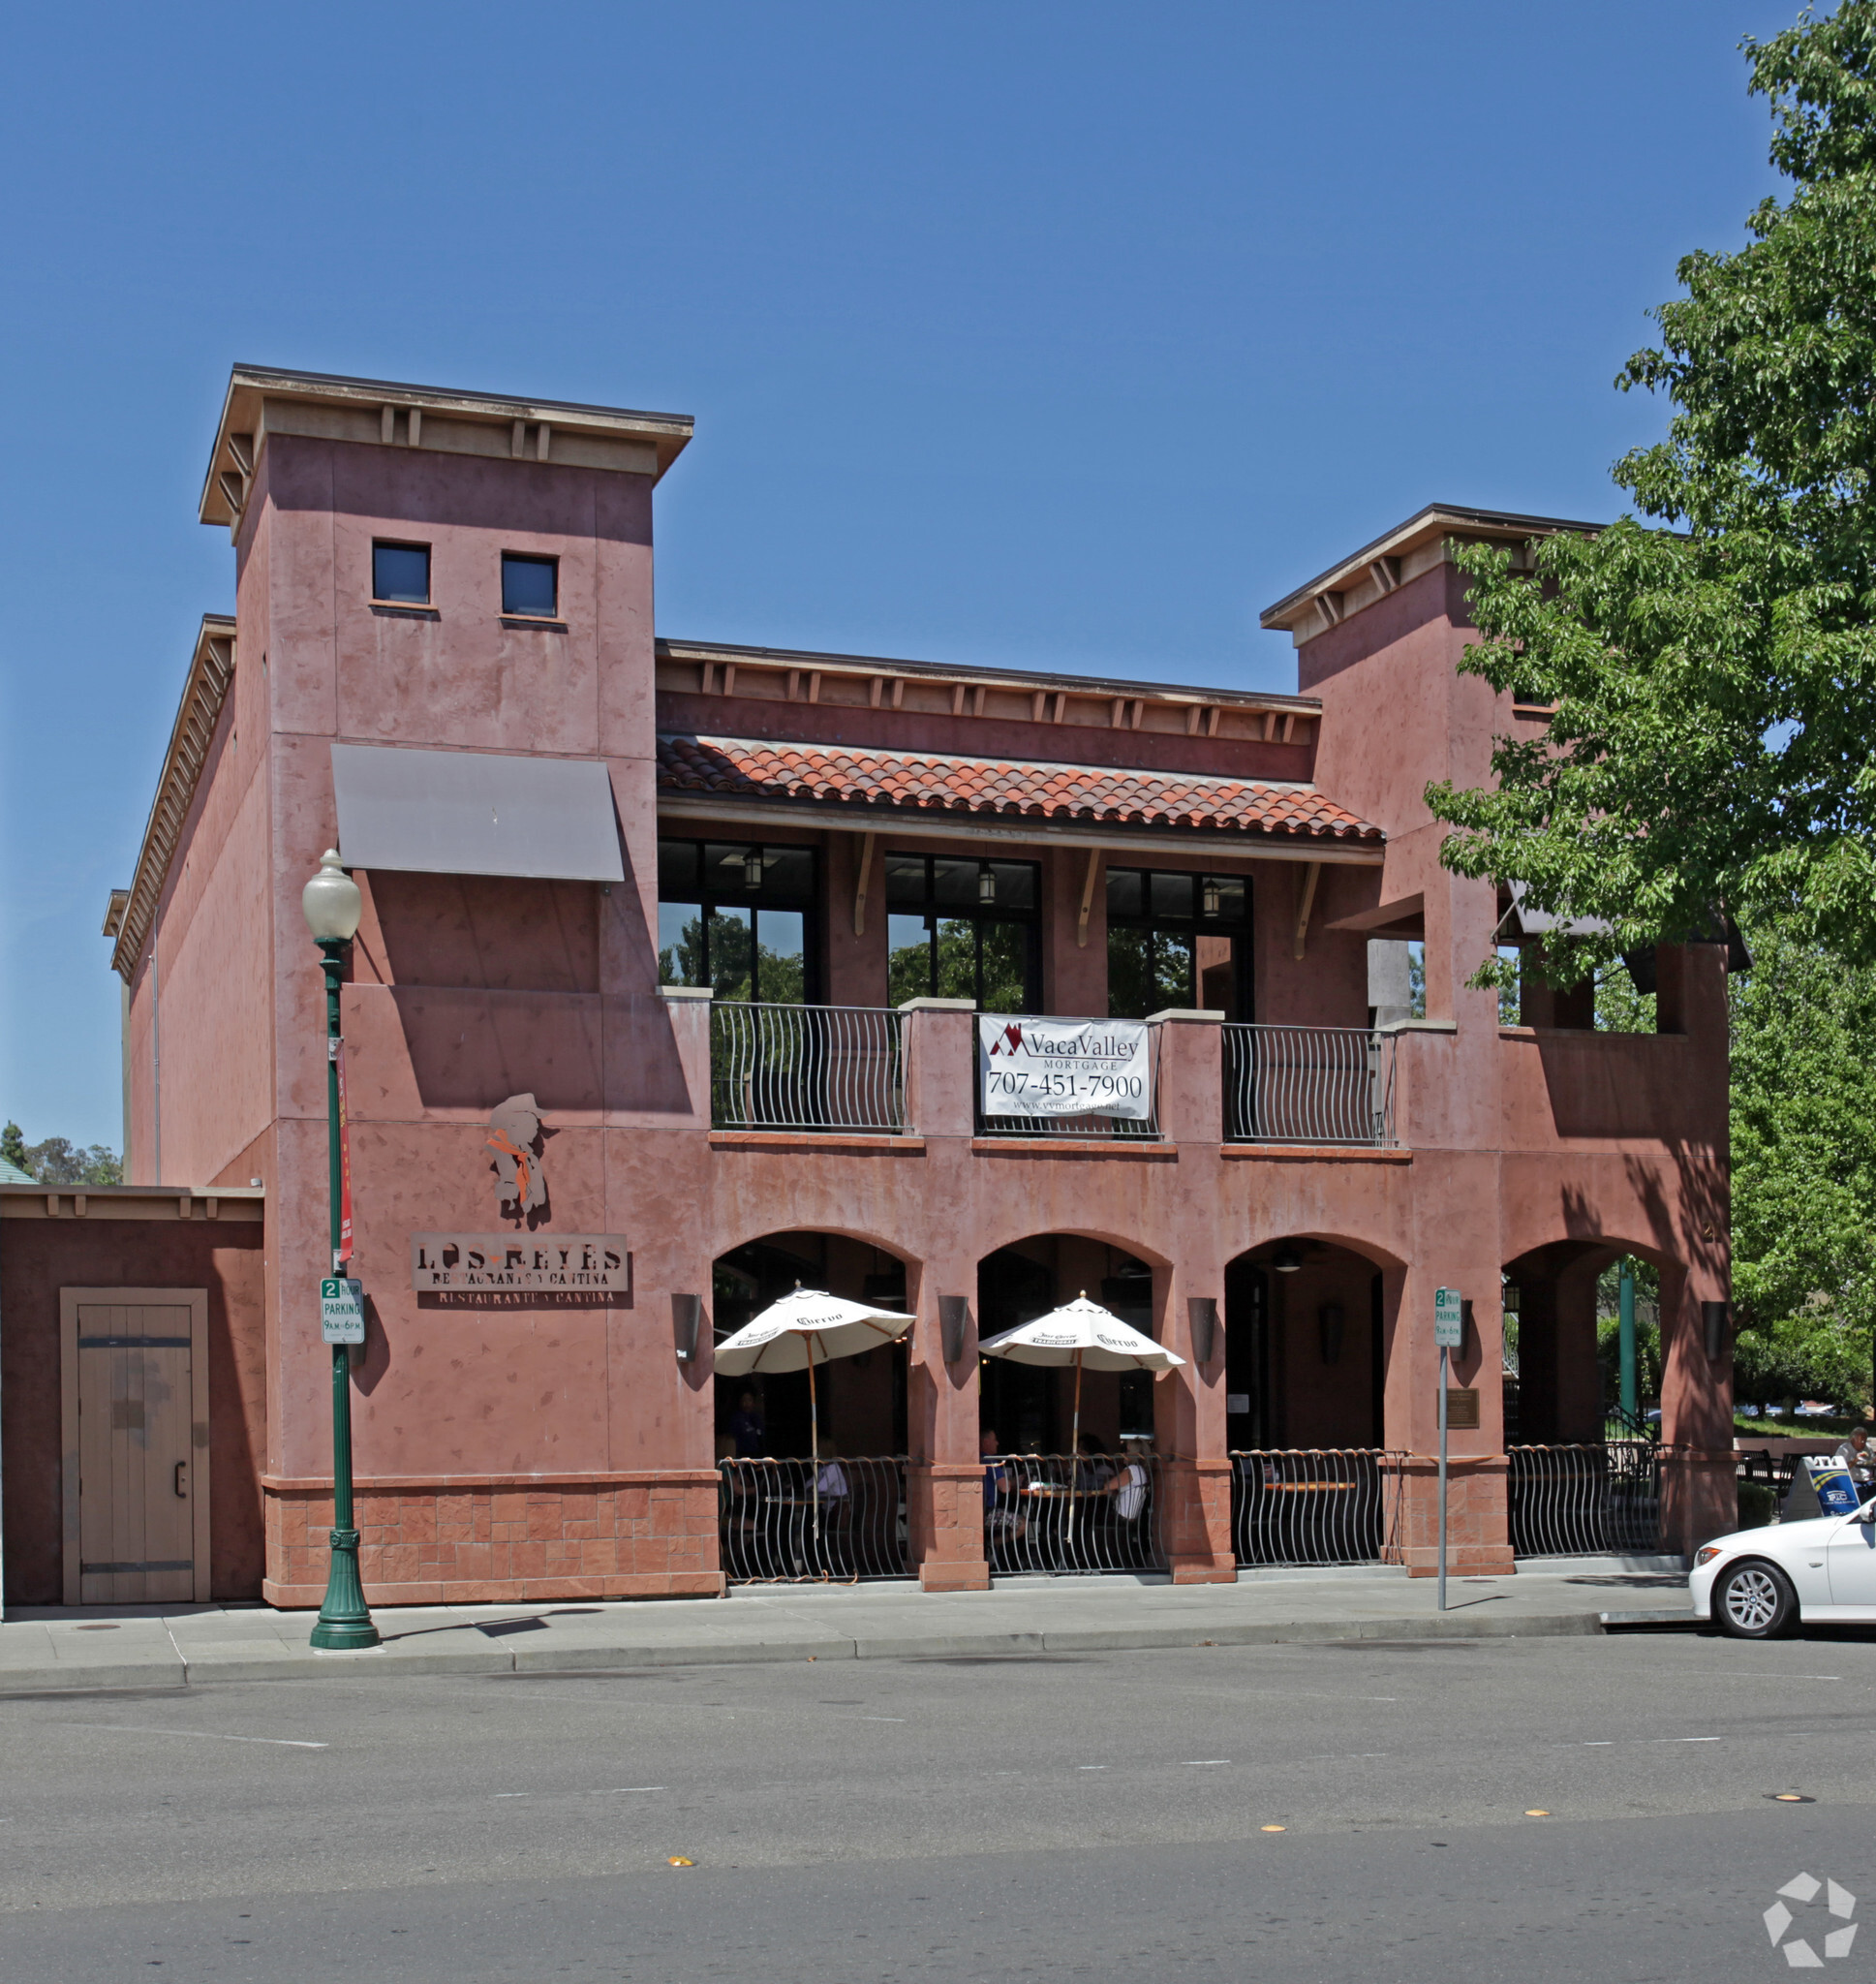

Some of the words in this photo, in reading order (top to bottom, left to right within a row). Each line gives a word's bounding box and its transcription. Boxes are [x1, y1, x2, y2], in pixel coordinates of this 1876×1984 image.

[1030, 1033, 1139, 1058] VacaValley
[1043, 1059, 1118, 1071] MORTGAGE
[989, 1071, 1142, 1098] 707-451-7900
[1013, 1100, 1121, 1113] www.vvmortgage.net
[416, 1242, 485, 1270] LOS
[504, 1243, 622, 1270] REYES
[549, 1273, 609, 1285] CANTINA
[325, 1282, 336, 1297] 2
[342, 1286, 359, 1295] HOUR
[1436, 1292, 1444, 1305] 2
[324, 1304, 360, 1315] PARKING
[796, 1313, 844, 1326] Cuervo
[1436, 1312, 1460, 1321] PARKING
[1096, 1334, 1139, 1348] Cuervo
